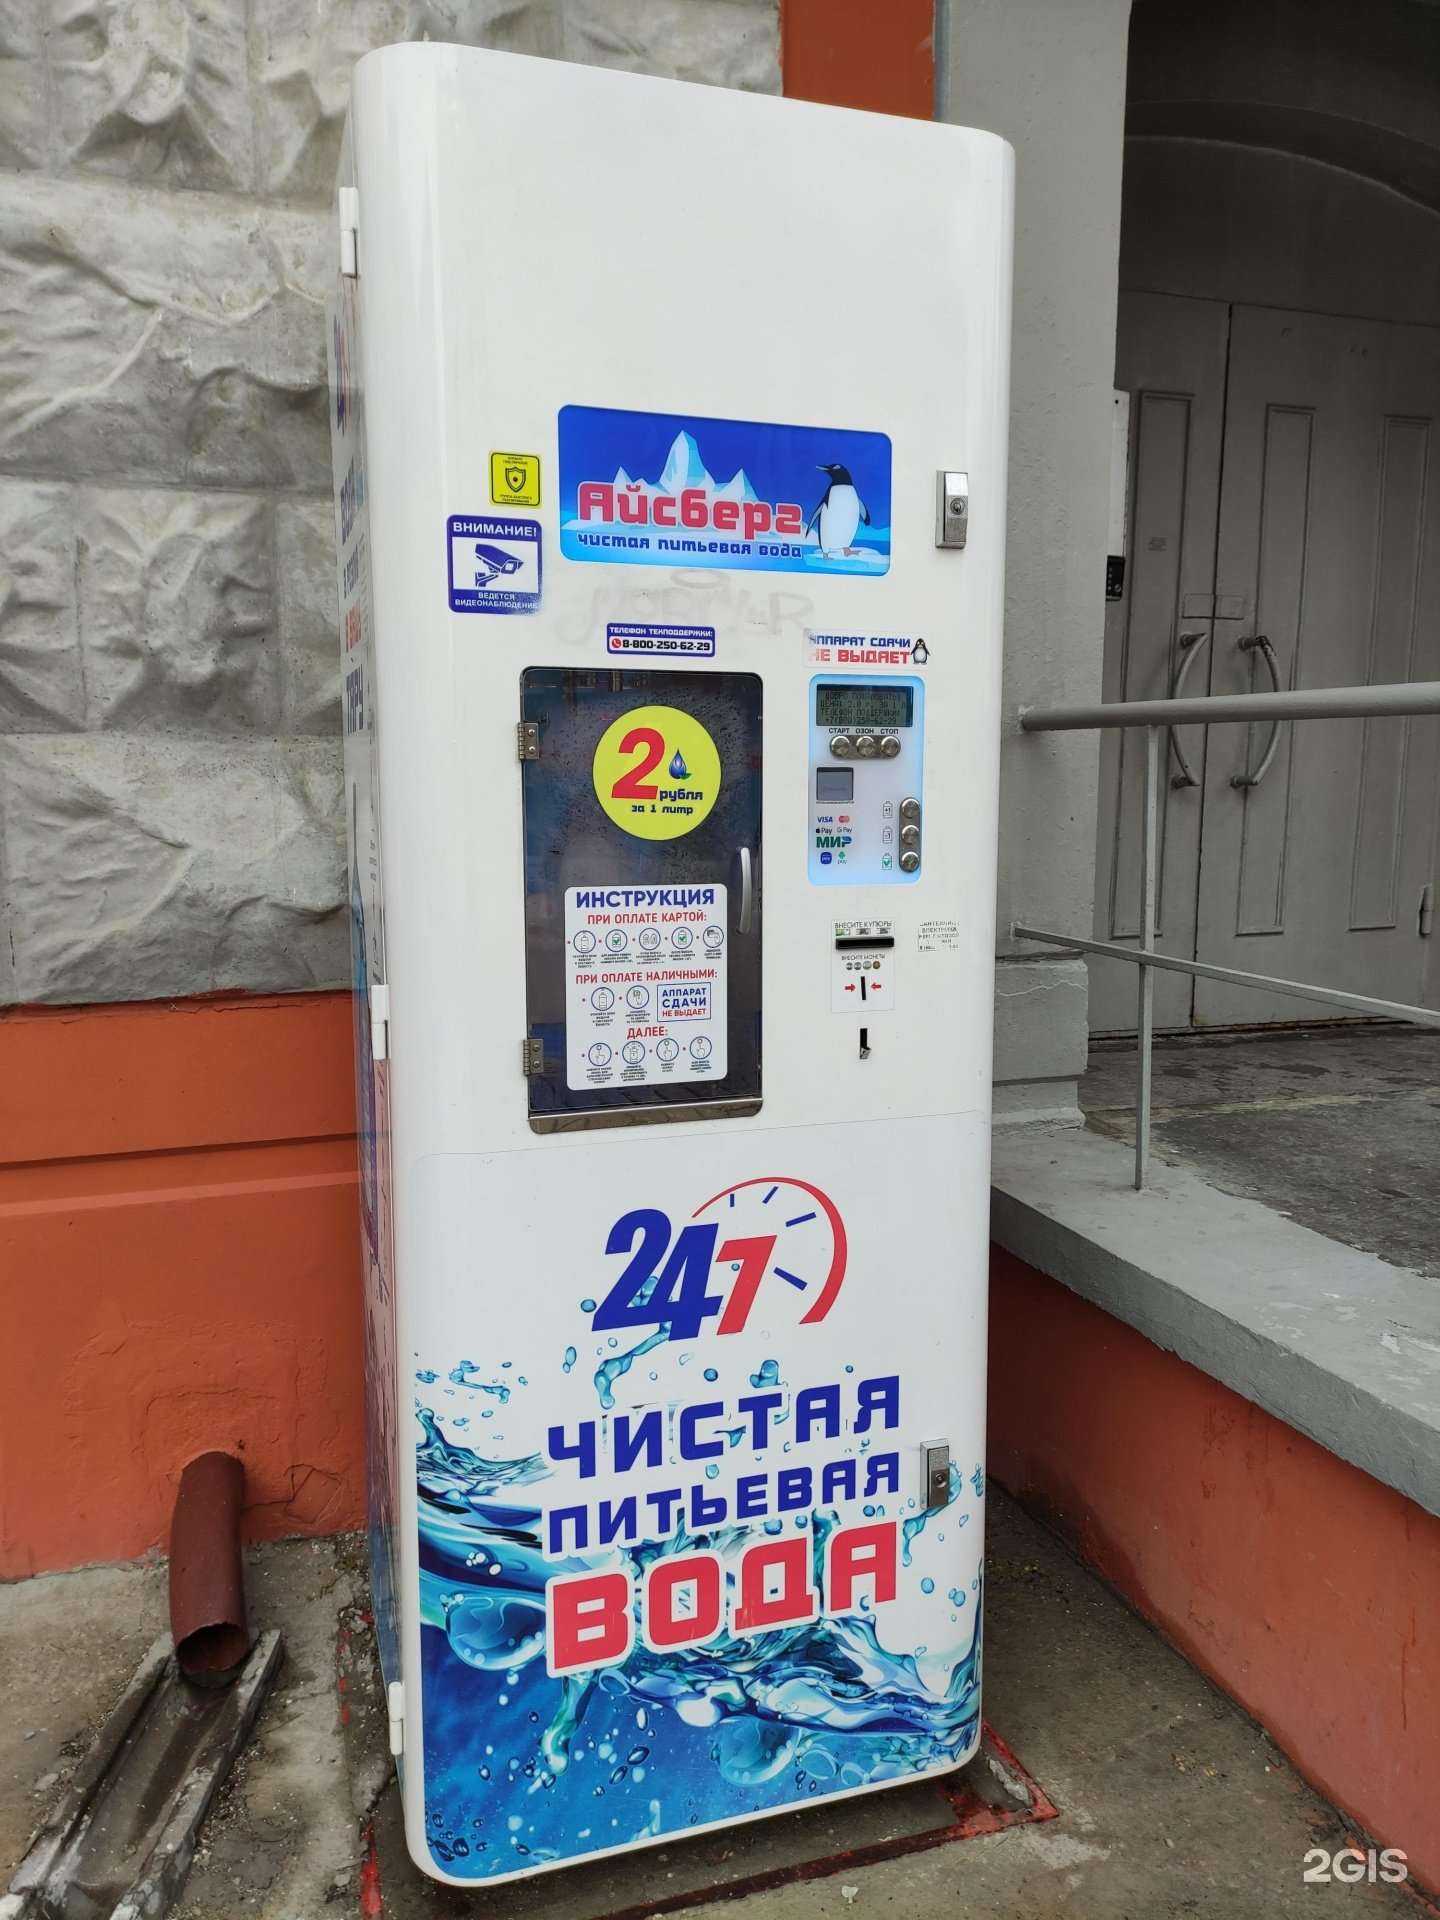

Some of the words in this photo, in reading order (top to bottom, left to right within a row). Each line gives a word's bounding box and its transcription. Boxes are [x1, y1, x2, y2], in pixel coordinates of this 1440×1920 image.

[578, 481, 802, 540] Айсберг
[453, 521, 537, 538] ВНИМАНИЕ!
[577, 533, 650, 550] чистая
[657, 537, 751, 556] питьевая
[758, 544, 802, 559] вода
[478, 591, 515, 601] ВЕДЕТСЯ
[609, 626, 647, 635] ТЕЛЕФОН
[649, 627, 713, 637] ТЕХПОДДЕРЖКИ:
[622, 638, 711, 651] 8-800-250-62-29
[870, 637, 911, 648] СДАЧИ
[837, 649, 911, 664] ВЫДАЕТ
[828, 727, 850, 735] СТАРТ
[855, 727, 875, 735] ОЗОН
[611, 727, 666, 800] 2
[659, 788, 704, 801] рубля
[631, 804, 645, 813] за
[650, 805, 657, 813] 1
[815, 836, 853, 848] МИР
[576, 888, 715, 908] ИНСТРУКЦИЯ
[587, 914, 611, 925] ПРИ
[614, 912, 658, 924] ОПЛАТЕ
[661, 909, 707, 923] КАРТОЙ:
[575, 974, 598, 984] ПРИ
[601, 972, 643, 983] ОПЛАТЕ
[646, 968, 718, 982] НАЛИЧНЫМИ:
[662, 987, 707, 997] АППАРАТ
[662, 997, 707, 1009] СДАЧИ
[662, 1009, 673, 1017] НЕ
[674, 1008, 706, 1017] ВЫДАЕТ
[626, 1026, 668, 1040] ДАЛЕЕ:
[547, 1375, 900, 1479] ЧИСТАЯ
[549, 1451, 900, 1555] ПИТЬЕВАЯ
[553, 1521, 898, 1671] ВОДА
